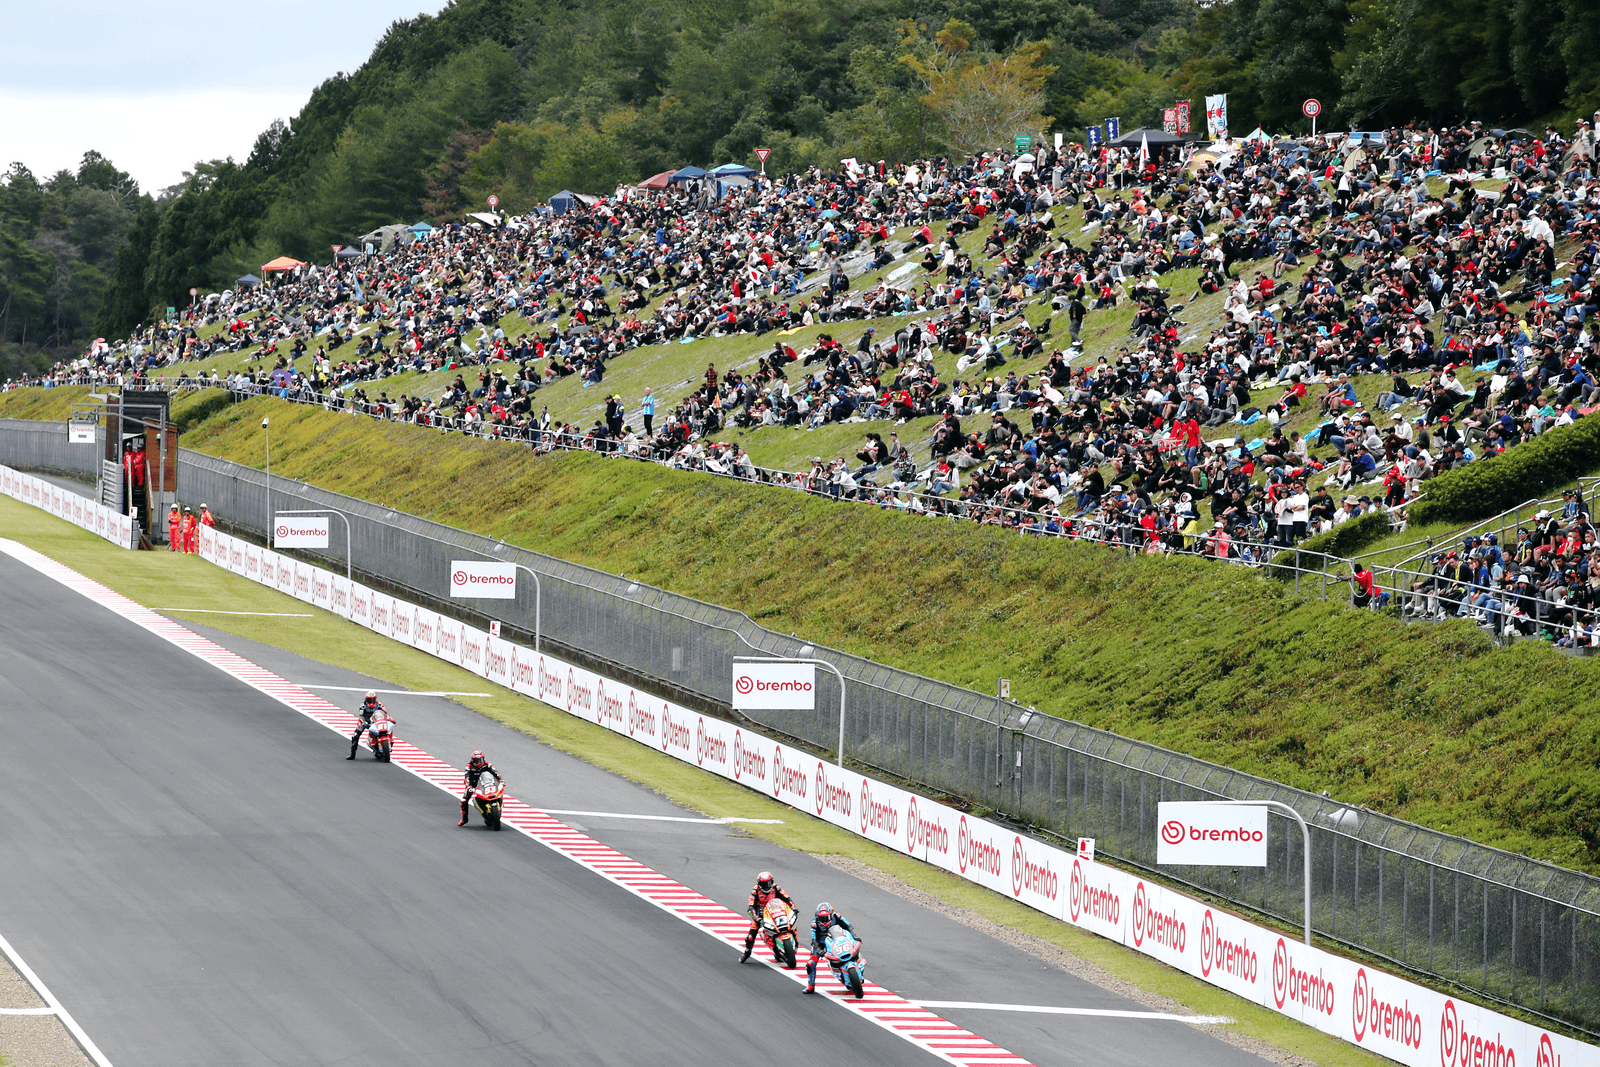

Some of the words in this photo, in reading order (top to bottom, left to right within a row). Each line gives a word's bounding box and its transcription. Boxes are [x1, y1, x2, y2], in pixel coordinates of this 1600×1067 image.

[1307, 104, 1318, 113] 30
[290, 528, 327, 536] brembo
[469, 574, 514, 585] brembo
[417, 617, 432, 643] brembo
[441, 627, 456, 652] brembo
[465, 638, 480, 667] brembo
[491, 648, 506, 676] brembo
[516, 658, 533, 686] brembo
[544, 668, 562, 698] brembo
[756, 680, 812, 692] brembo
[573, 680, 591, 710] brembo
[604, 691, 623, 722] brembo
[635, 703, 655, 736] brembo
[670, 715, 690, 750] brembo
[704, 729, 726, 764] brembo
[743, 742, 765, 780] brembo
[782, 759, 807, 798] brembo
[825, 776, 851, 817] brembo
[870, 795, 898, 835] brembo
[918, 811, 948, 854] brembo
[1190, 826, 1263, 842] brembo
[969, 831, 1000, 877] brembo
[1024, 852, 1058, 901] brembo
[1083, 875, 1119, 925] brembo
[775, 916, 787, 926] 13
[1147, 898, 1186, 953] brembo
[836, 943, 850, 954] 96
[1216, 927, 1257, 983] brembo
[1289, 957, 1334, 1015] brembo
[1371, 987, 1421, 1049] brembo
